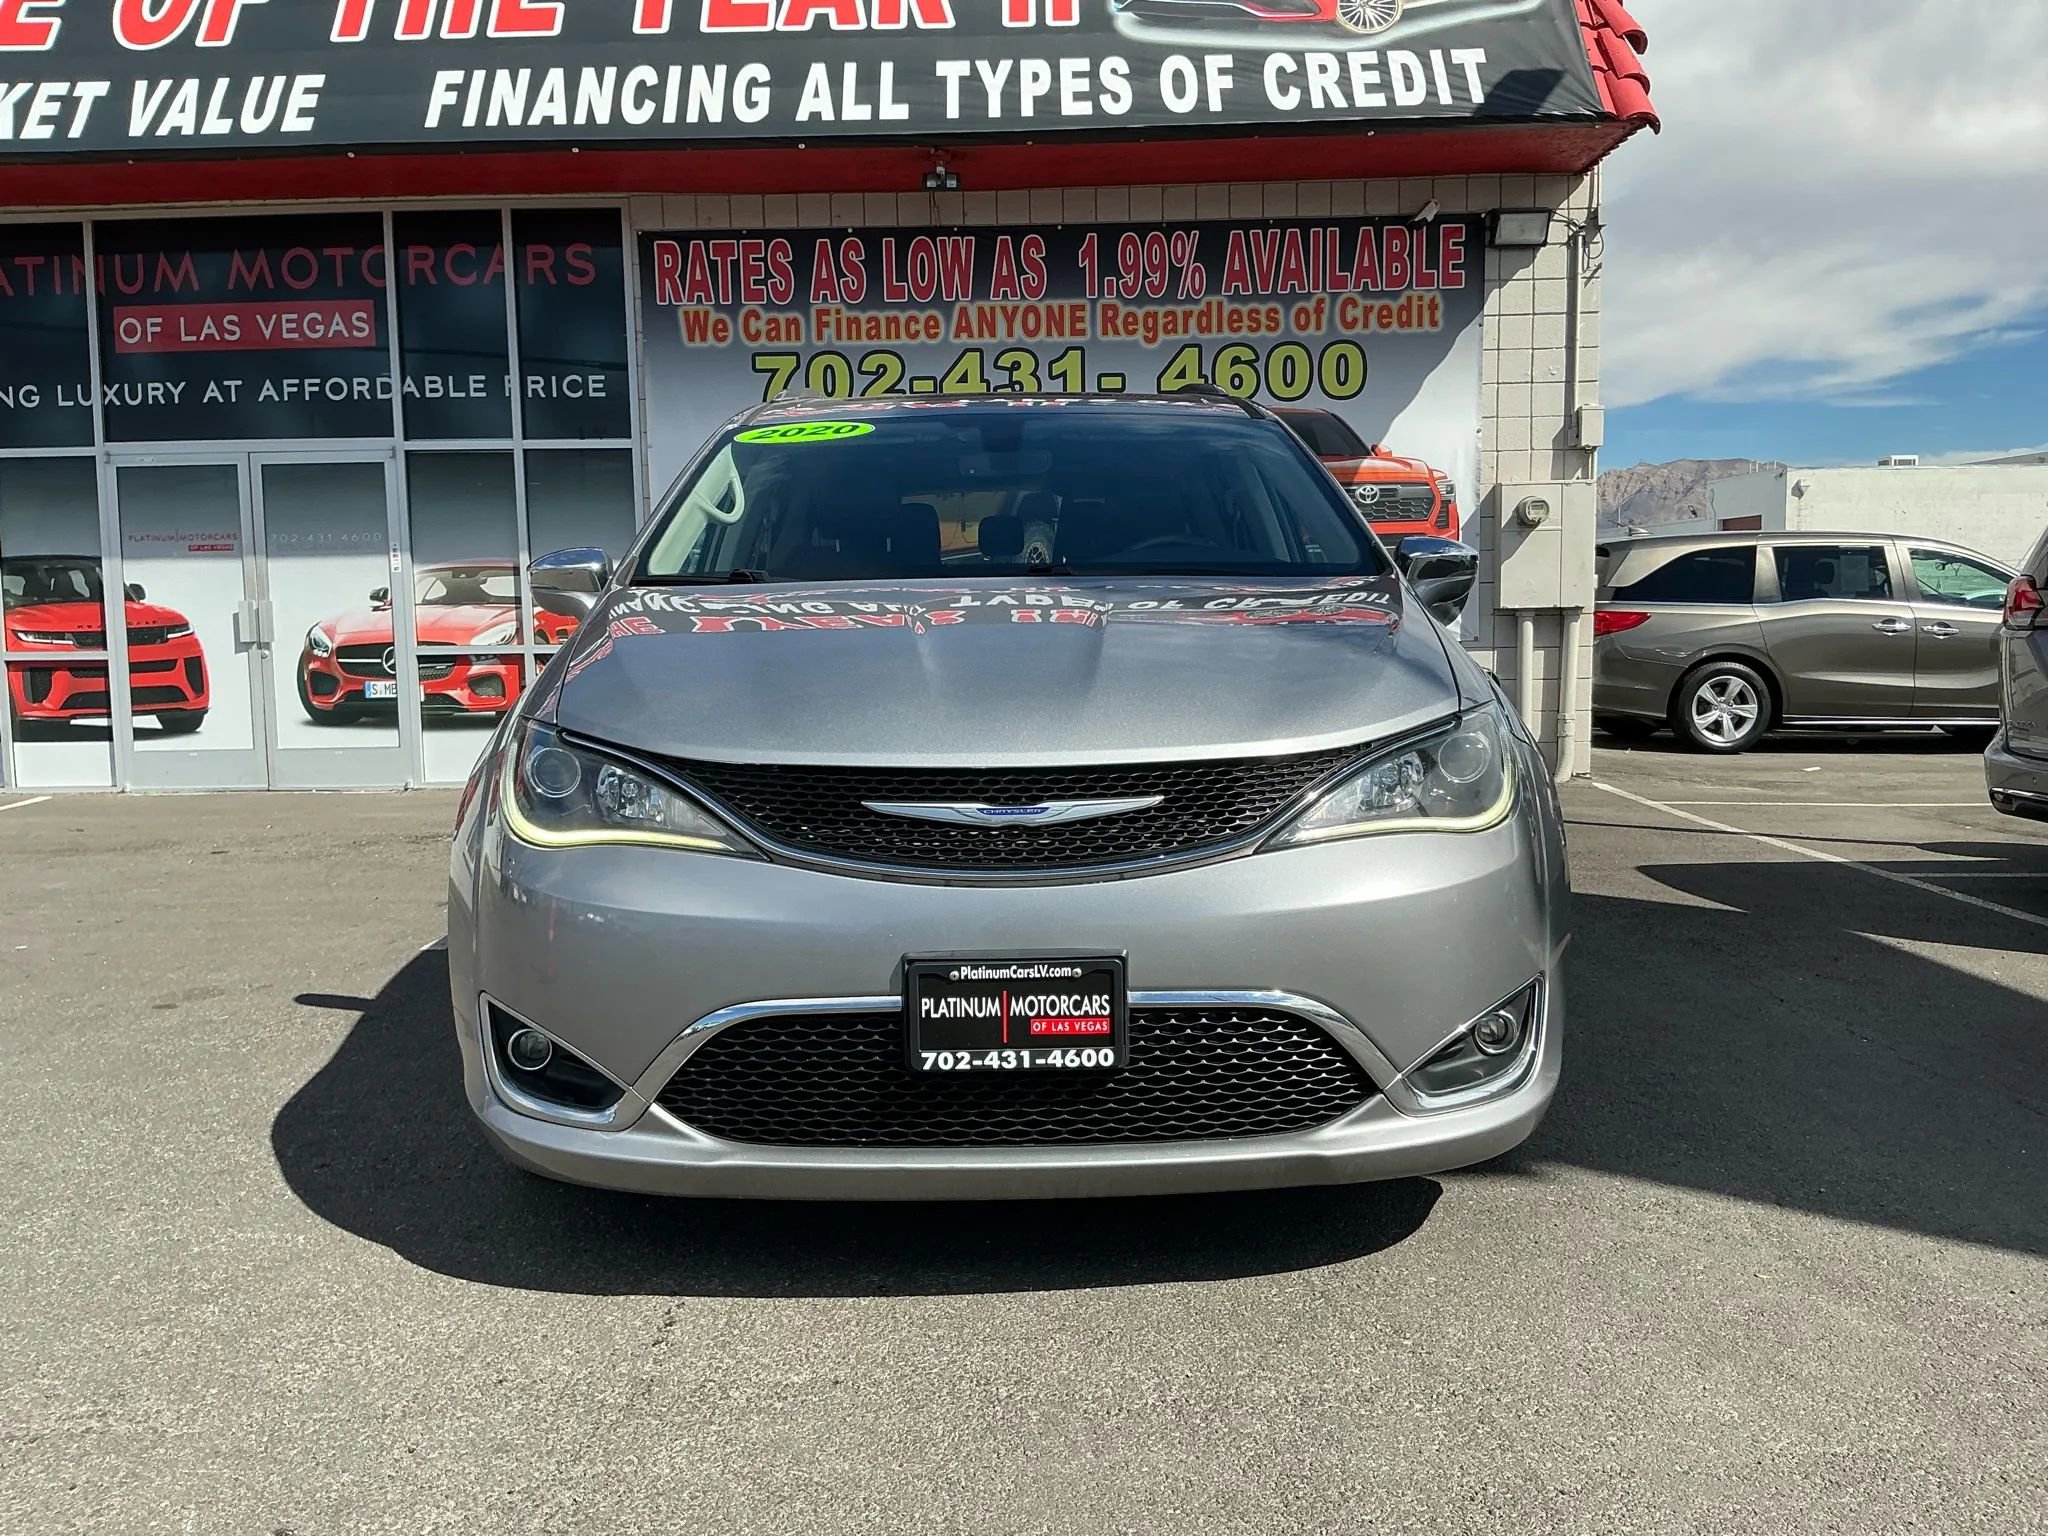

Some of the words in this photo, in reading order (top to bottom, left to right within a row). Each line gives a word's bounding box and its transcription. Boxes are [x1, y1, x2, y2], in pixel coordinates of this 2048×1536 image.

[424, 62, 771, 128] FINANCING
[795, 61, 909, 121] ALL
[936, 55, 1133, 119] TYPES
[1159, 54, 1234, 113] OF
[1263, 48, 1487, 111] CREDIT
[128, 74, 326, 137] VALUE
[227, 243, 597, 293] MOTORCARS
[654, 238, 794, 305] RATES
[810, 237, 867, 303] AS
[882, 235, 976, 303] LOW
[990, 234, 1047, 301] AS
[1078, 230, 1206, 299] 1.99%
[1221, 224, 1466, 295] AVAILABLE
[118, 317, 163, 345] OF
[179, 314, 241, 342] LAS
[256, 311, 370, 341] VEGAS
[682, 308, 730, 345] We
[741, 308, 801, 343] Can
[813, 306, 942, 343] Finance
[953, 302, 1087, 341] ANYONE
[1100, 301, 1281, 345] Regardless
[1294, 295, 1325, 333] of
[1338, 293, 1441, 331] Credit
[1156, 339, 1368, 402] 4600
[57, 380, 187, 408] LUXURY
[202, 378, 243, 404] AT
[257, 374, 488, 403] AFFORDABLE
[748, 424, 860, 441] 2020
[960, 965, 1072, 980] PlatinumCarsLV.com
[921, 997, 1001, 1018] PLATINUM
[1010, 995, 1110, 1017] MOTORCARS
[1032, 1022, 1046, 1032] OF
[1051, 1022, 1069, 1032] LAS
[1074, 1020, 1108, 1031] VEGAS
[920, 1048, 1114, 1070] 702-431-4600
